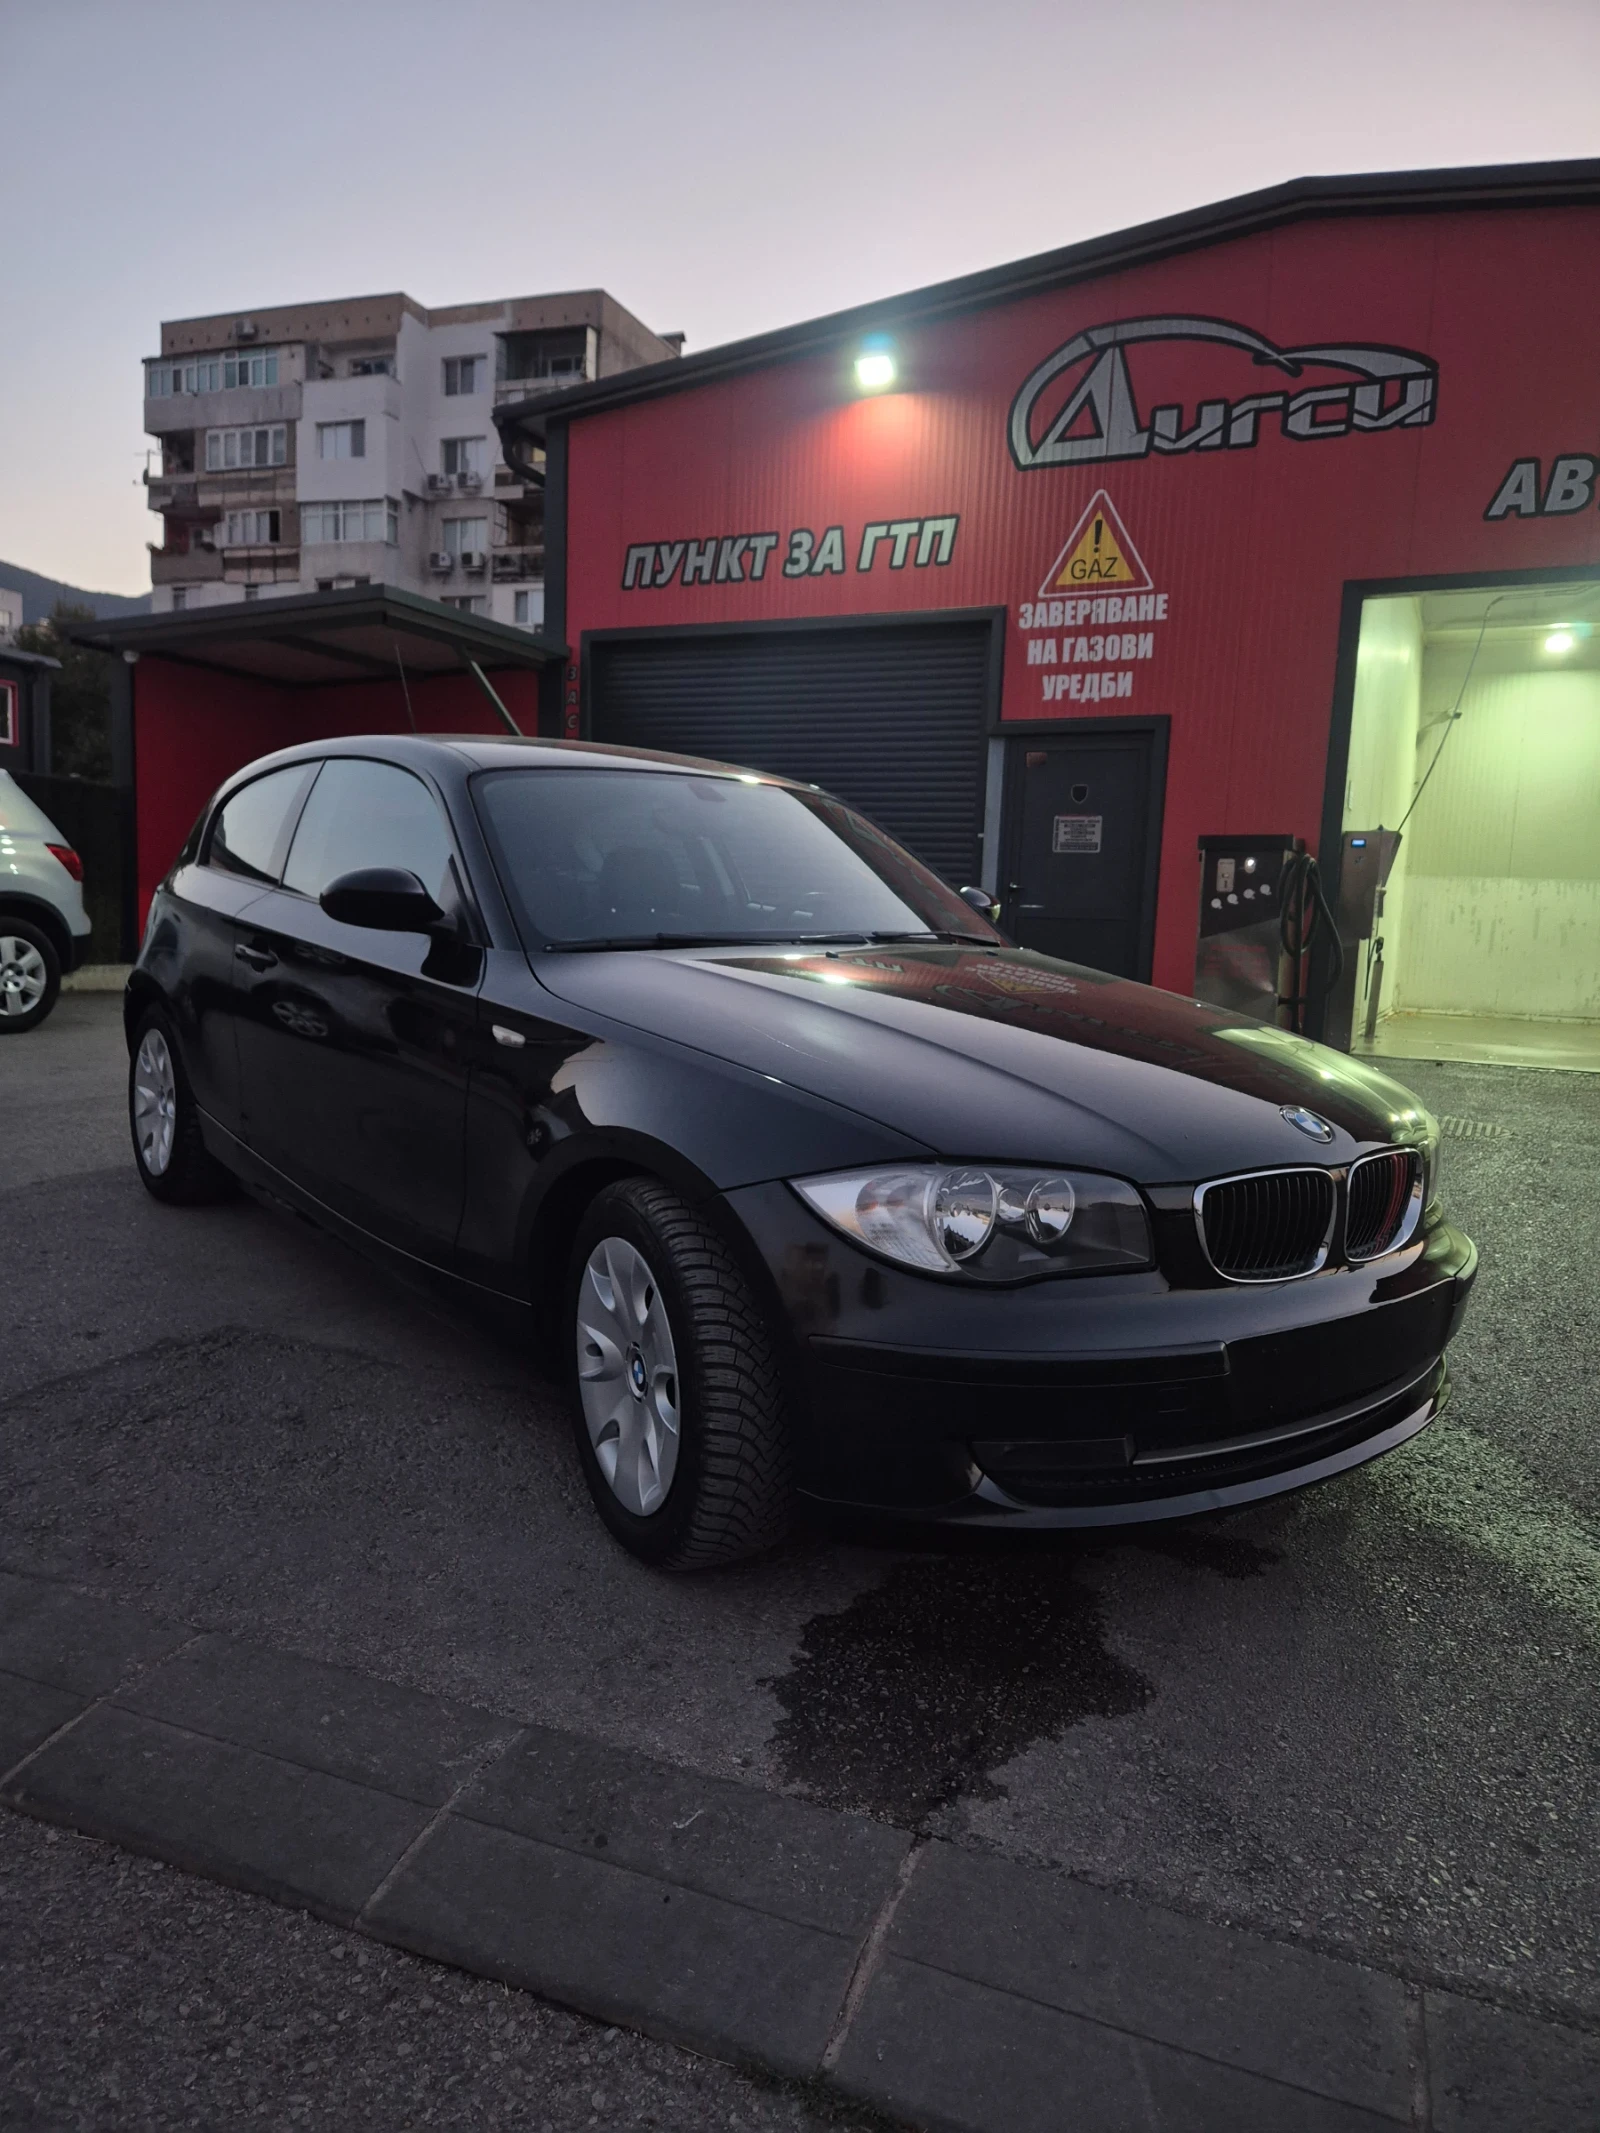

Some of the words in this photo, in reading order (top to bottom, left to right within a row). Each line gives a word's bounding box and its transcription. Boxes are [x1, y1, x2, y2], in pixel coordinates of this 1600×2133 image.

[1484, 454, 1600, 520] АВ
[623, 534, 777, 588] ПУНКТ
[784, 526, 844, 576] ЗА
[858, 515, 958, 571] ГТП
[1070, 557, 1118, 580] GAZ
[1018, 593, 1169, 630] ЗАВЕРЯВАНЕ
[1027, 638, 1058, 665] НА
[1062, 632, 1154, 662] ГАЗОВИ
[1042, 671, 1133, 703] УРЕДБИ
